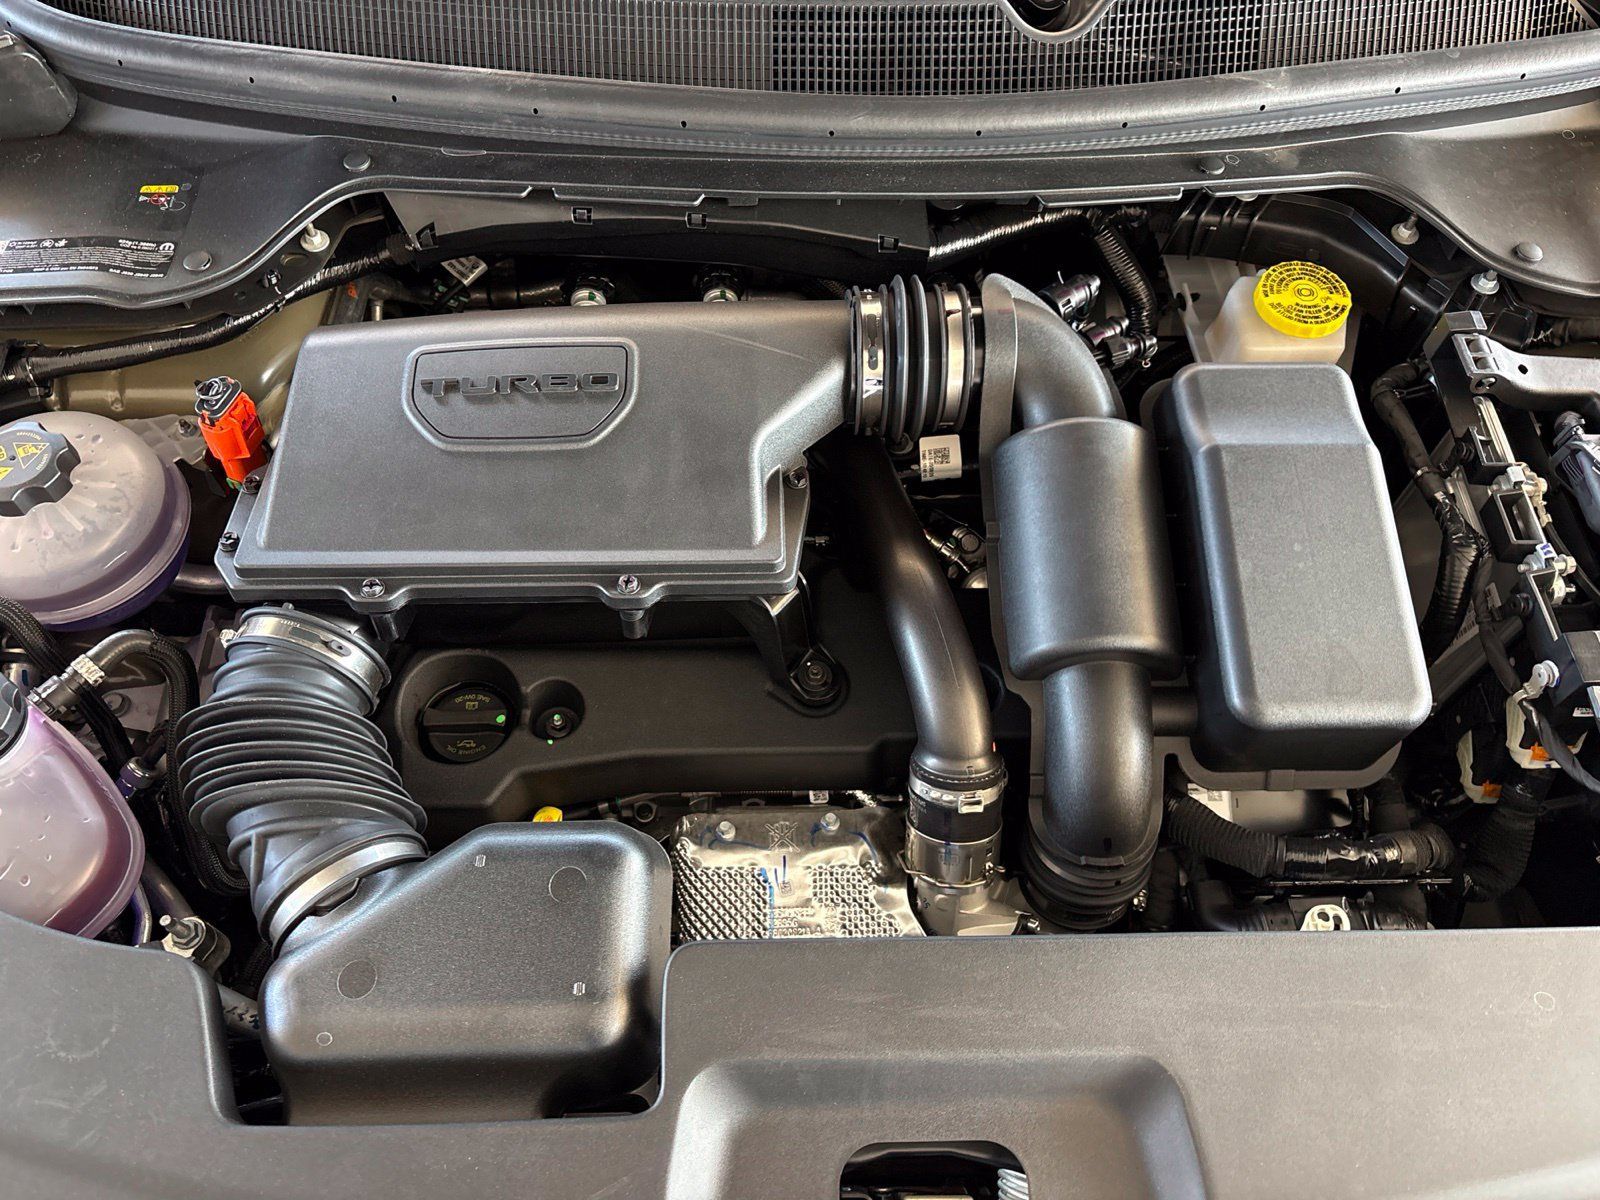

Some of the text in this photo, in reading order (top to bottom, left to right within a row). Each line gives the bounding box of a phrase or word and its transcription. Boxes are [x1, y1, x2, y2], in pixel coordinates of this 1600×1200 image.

[421, 373, 619, 398] TURBO
[477, 694, 491, 702] SAE
[447, 744, 486, 755] ENGINE OIL
